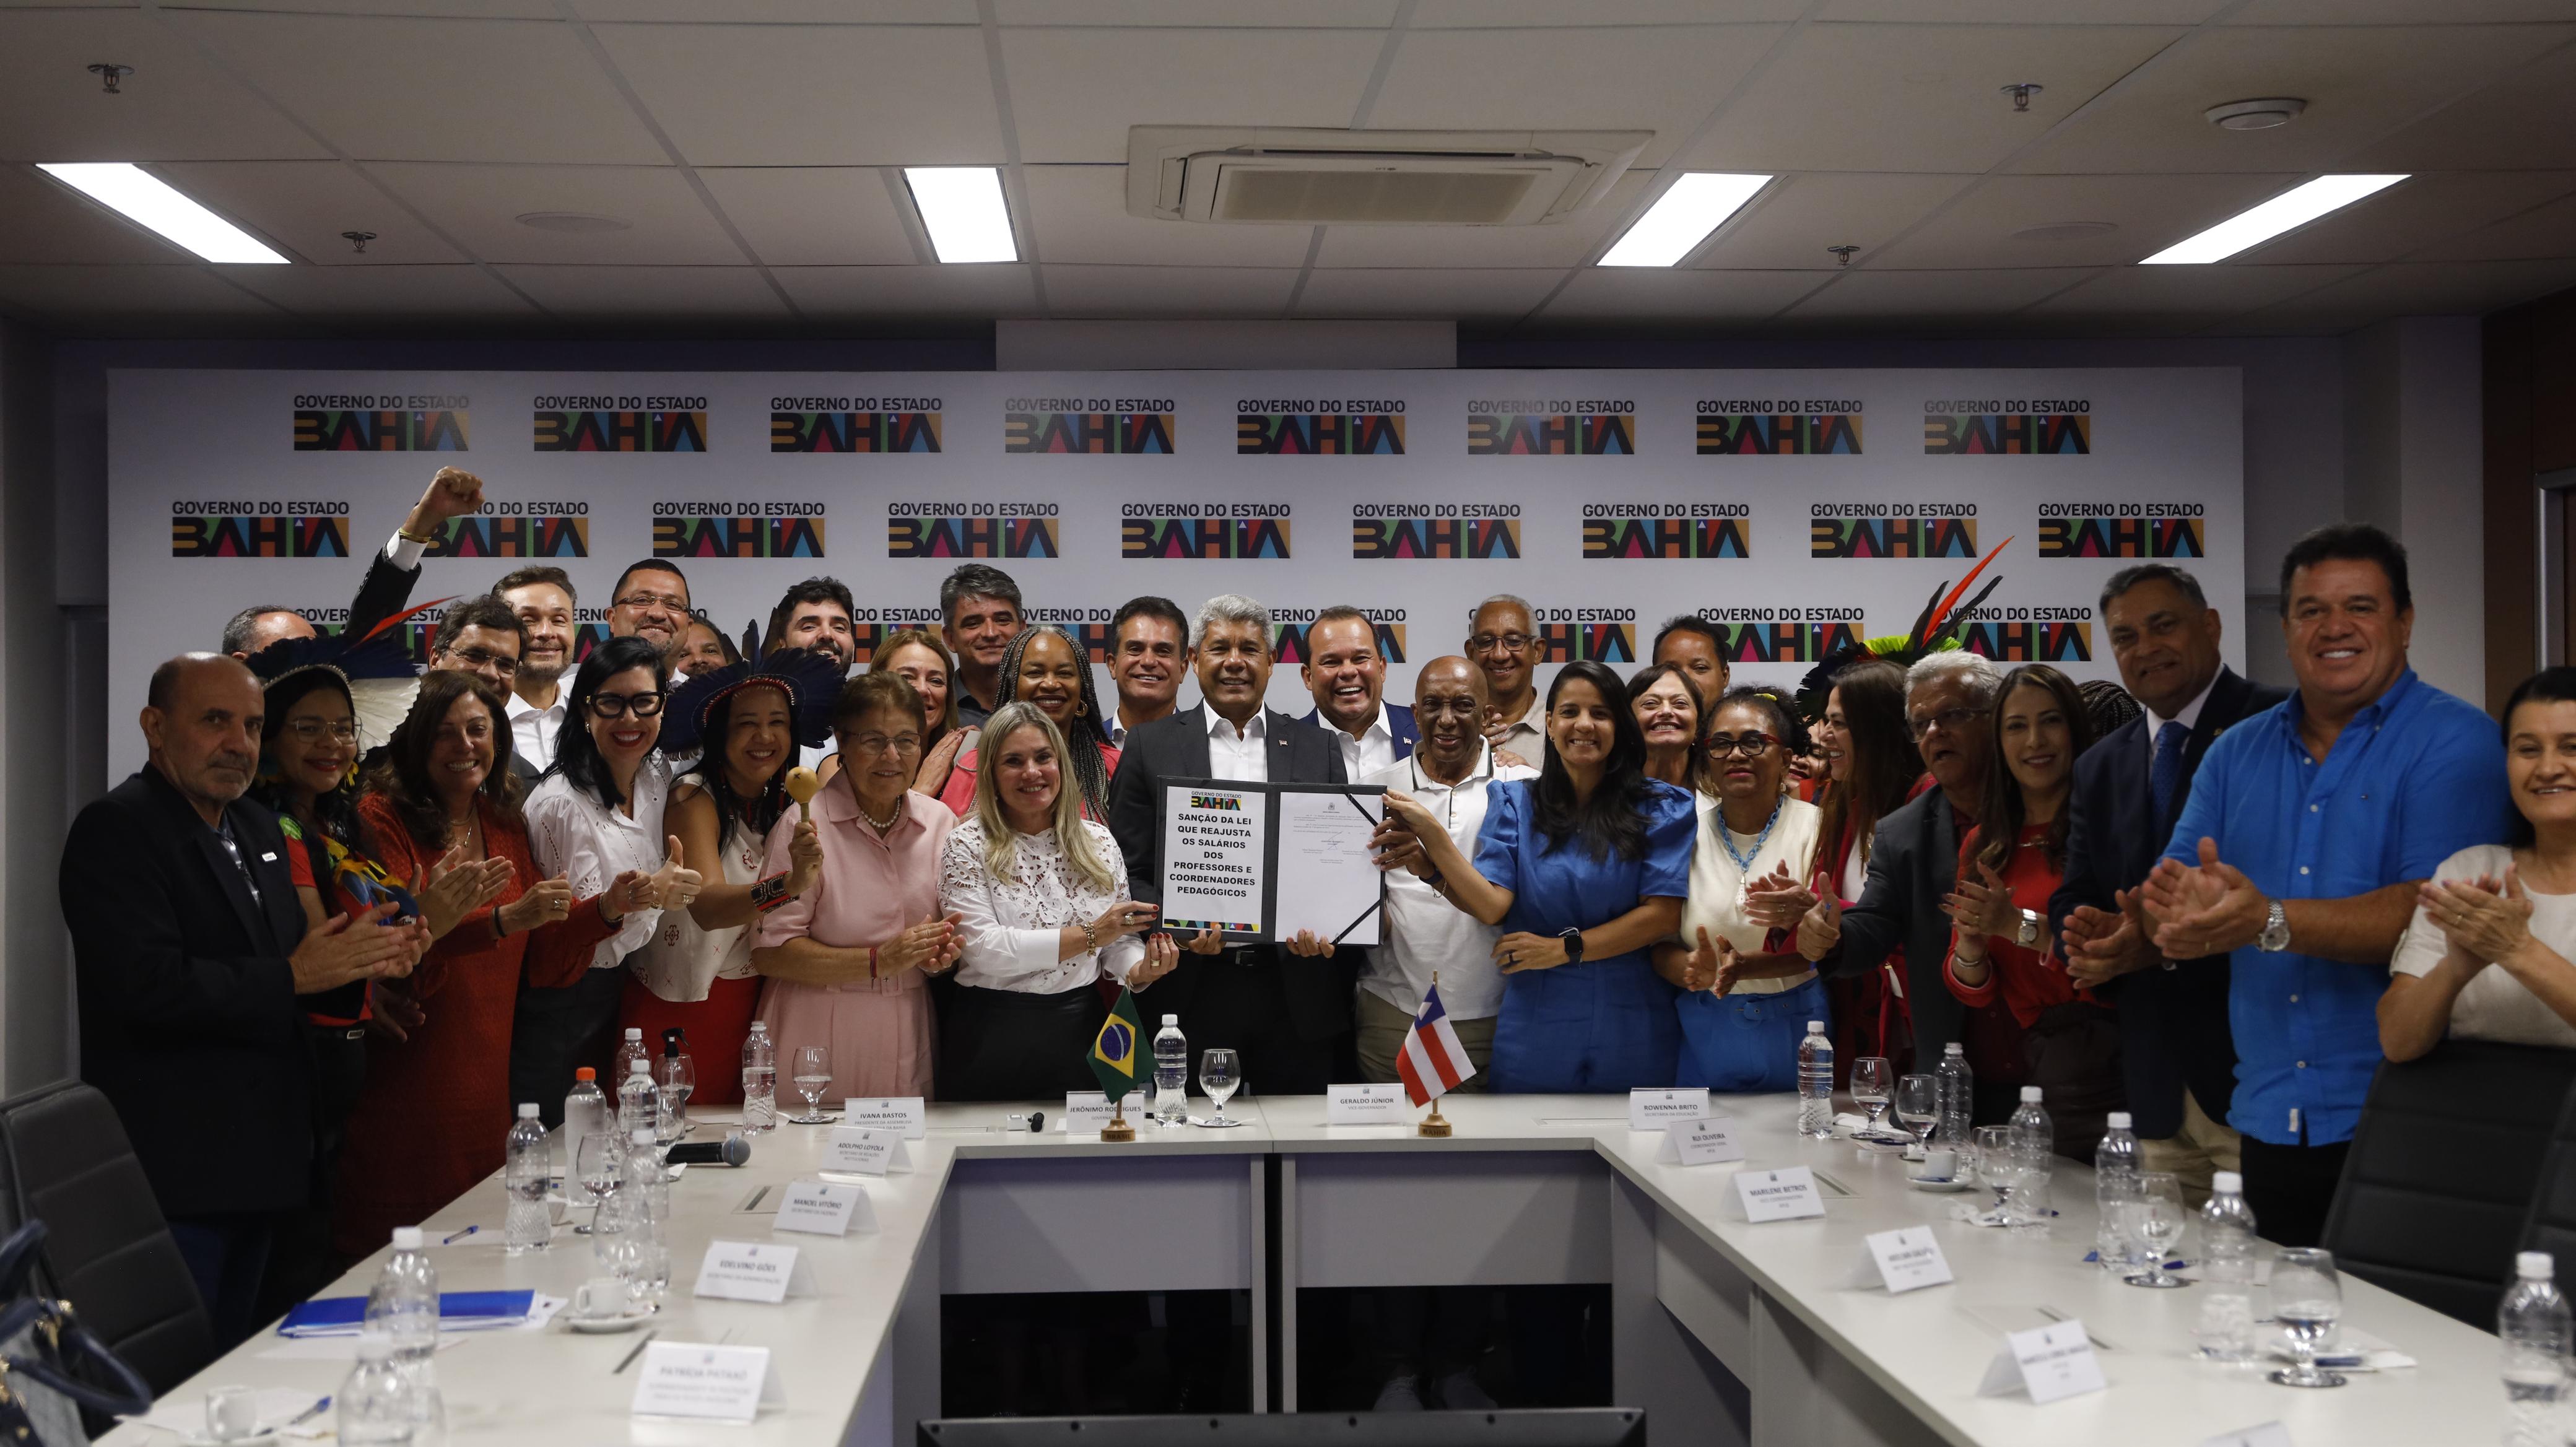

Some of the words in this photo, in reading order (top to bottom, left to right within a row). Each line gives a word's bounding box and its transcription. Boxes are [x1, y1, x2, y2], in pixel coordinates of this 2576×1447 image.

[294, 395, 374, 408] GOVERNO
[380, 395, 402, 408] DO
[409, 395, 469, 408] ESTADO
[534, 396, 614, 409] GOVERNO
[619, 396, 642, 409] DO
[647, 396, 707, 409] ESTADO
[771, 398, 850, 411] GOVERNO
[855, 398, 877, 411] DO
[882, 398, 941, 411] ESTADO
[1006, 399, 1083, 412] GOVERNO
[1089, 399, 1110, 412] DO
[1116, 399, 1174, 412] ESTADO
[1238, 399, 1315, 412] GOVERNO
[1320, 399, 1341, 412] DO
[1347, 399, 1405, 412] ESTADO
[1468, 401, 1544, 413] GOVERNO
[1550, 401, 1571, 413] DO
[1577, 401, 1635, 413] ESTADO
[1697, 400, 1773, 413] GOVERNO
[1778, 400, 1799, 413] DO
[1805, 400, 1863, 413] ESTADO
[1925, 400, 2000, 412] GOVERNO
[2006, 400, 2027, 412] DO
[2032, 400, 2091, 412] ESTADO
[294, 411, 469, 451] BAHIA
[534, 412, 707, 452] BAHIA
[771, 412, 941, 453] BAHIA
[1006, 414, 1174, 454] BAHIA
[1238, 415, 1405, 454] BAHIA
[1468, 415, 1635, 454] BAHIA
[1697, 415, 1863, 454] BAHIA
[1925, 415, 2091, 454] BAHIA
[172, 501, 254, 515] GOVERNO
[259, 501, 282, 515] DO
[288, 501, 349, 515] ESTADO
[500, 502, 523, 515] DO
[528, 502, 588, 515] ESTADO
[653, 503, 732, 515] GOVERNO
[738, 503, 760, 515] DO
[765, 503, 824, 515] ESTADO
[889, 503, 967, 516] GOVERNO
[972, 503, 994, 516] DO
[999, 503, 1058, 516] ESTADO
[1122, 504, 1199, 516] GOVERNO
[1204, 504, 1227, 516] DO
[1232, 504, 1290, 516] ESTADO
[1353, 504, 1430, 517] GOVERNO
[1435, 504, 1457, 517] DO
[1462, 504, 1520, 517] ESTADO
[1583, 504, 1659, 516] GOVERNO
[1664, 504, 1686, 516] DO
[1691, 504, 1749, 516] ESTADO
[1811, 504, 1887, 516] GOVERNO
[1892, 504, 1914, 516] DO
[1919, 504, 1977, 516] ESTADO
[2039, 503, 2114, 516] GOVERNO
[2120, 503, 2141, 516] DO
[2146, 503, 2204, 516] ESTADO
[172, 516, 349, 557] BAHIA
[653, 518, 824, 557] BAHIA
[889, 518, 1058, 558] BAHIA
[1122, 519, 1290, 558] BAHIA
[1353, 519, 1520, 558] BAHIA
[1583, 519, 1749, 558] BAHIA
[1811, 519, 1977, 558] BAHIA
[2039, 518, 2204, 558] BAHIA
[855, 609, 877, 621] DO
[883, 609, 942, 621] ESTADO
[1089, 609, 1111, 621] DO
[1551, 609, 1572, 621] DO
[1577, 609, 1635, 621] ESTADO
[1697, 608, 1774, 621] GOVERNO
[1779, 608, 1801, 620] DO
[1806, 608, 1864, 620] ESTADO
[2007, 607, 2028, 620] DO
[2034, 607, 2091, 620] ESTADO
[1191, 796, 1241, 810] BAHIA
[1178, 814, 1217, 823] SANÇÃO
[1178, 825, 1198, 833] QUE
[1201, 827, 1251, 837] REAJUSTA
[1198, 839, 1246, 849] SALÁRIOS
[1204, 851, 1224, 859] DOS
[1174, 861, 1243, 872] PROFESSORES
[1170, 874, 1255, 885] COORDENADORES
[1177, 887, 1247, 897] PEDAGÓGICOS
[1070, 1104, 1103, 1113] JERÔNIMO
